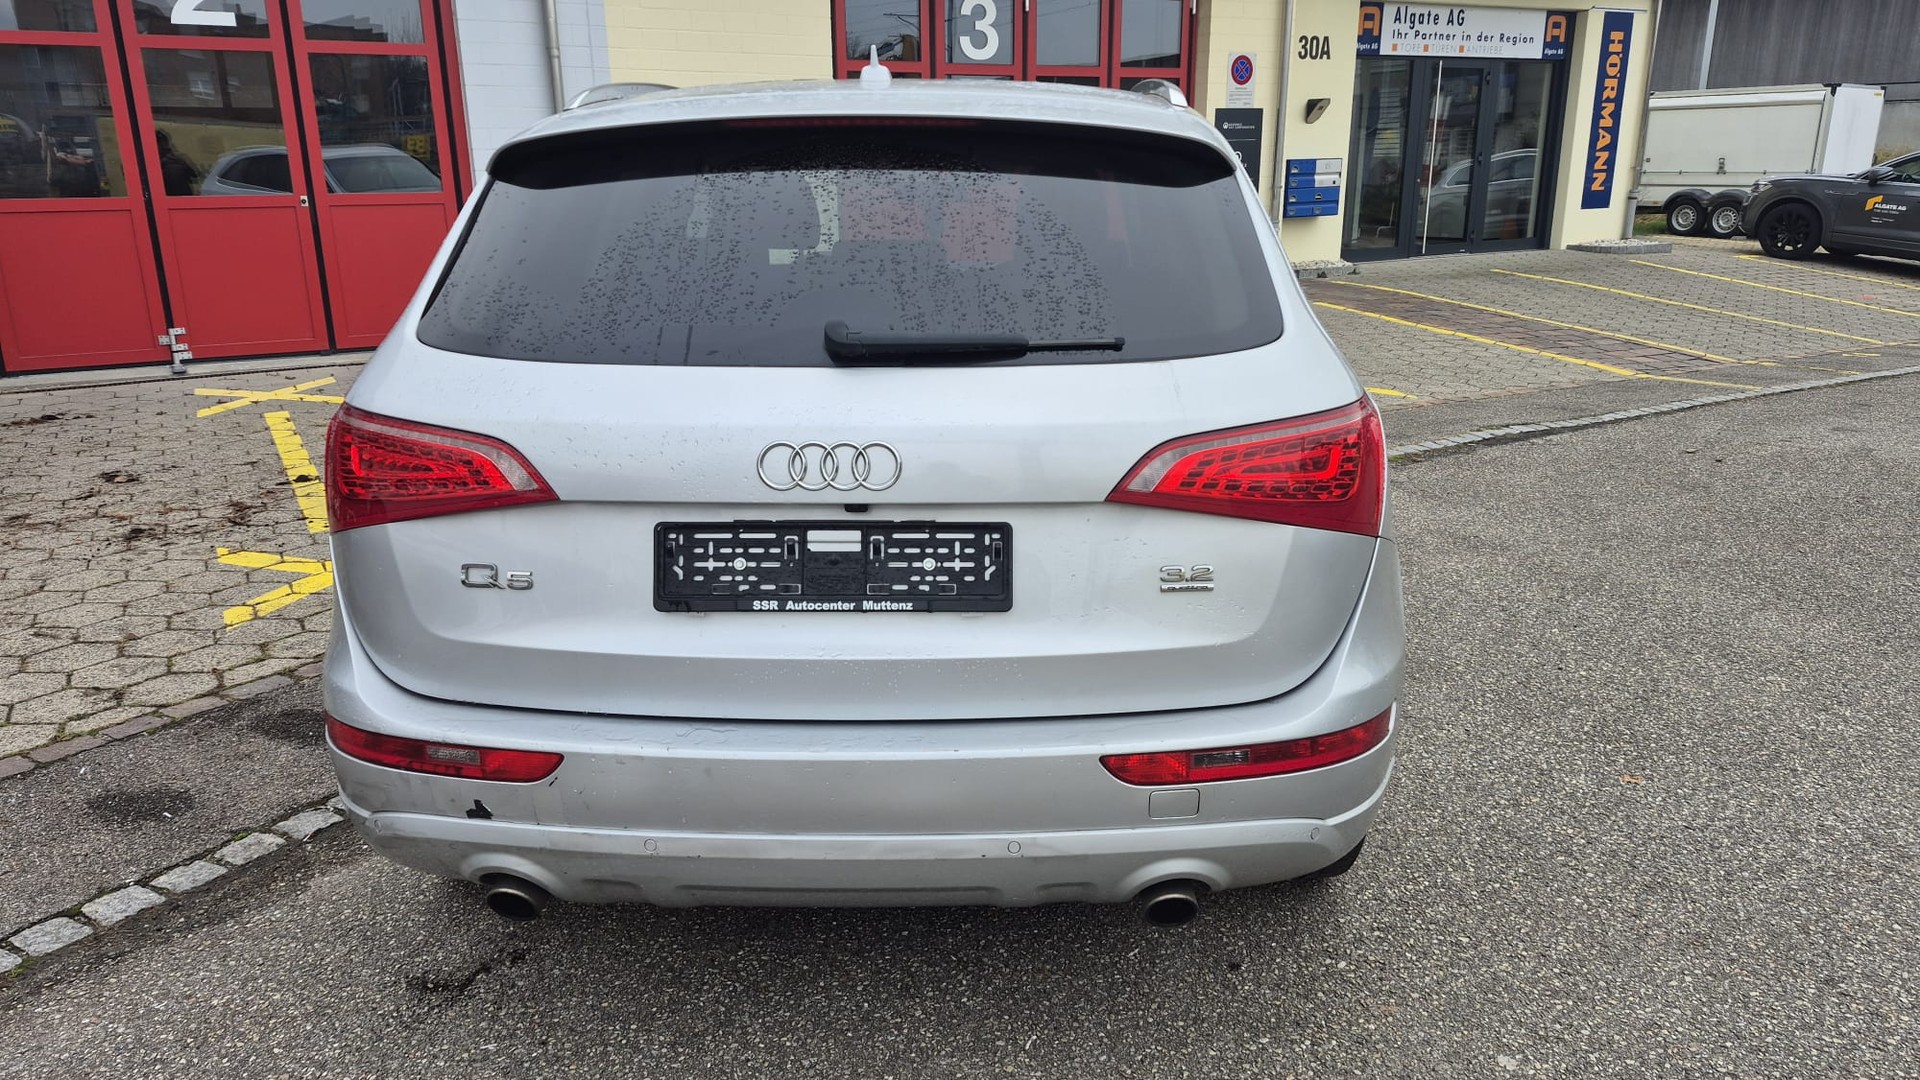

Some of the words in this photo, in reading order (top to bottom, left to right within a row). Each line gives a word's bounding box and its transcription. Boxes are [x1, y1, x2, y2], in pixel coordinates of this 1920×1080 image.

[959, 0, 999, 60] 3
[1358, 6, 1380, 36] A
[1394, 5, 1439, 30] Algate
[1447, 9, 1465, 26] AG
[1546, 15, 1567, 43] A
[1298, 35, 1331, 60] 30A
[1392, 29, 1408, 39] Ihr
[1414, 30, 1456, 41] Partner
[1461, 31, 1471, 41] in
[1477, 32, 1494, 42] der
[1499, 33, 1534, 46] Region
[1467, 45, 1504, 55] ANTRIEBE
[1591, 31, 1624, 191] HÖRMANN
[1160, 565, 1213, 582] 3.2
[752, 600, 779, 611] SSR
[785, 600, 856, 611] Autocenter
[862, 600, 914, 611] Muttenz
